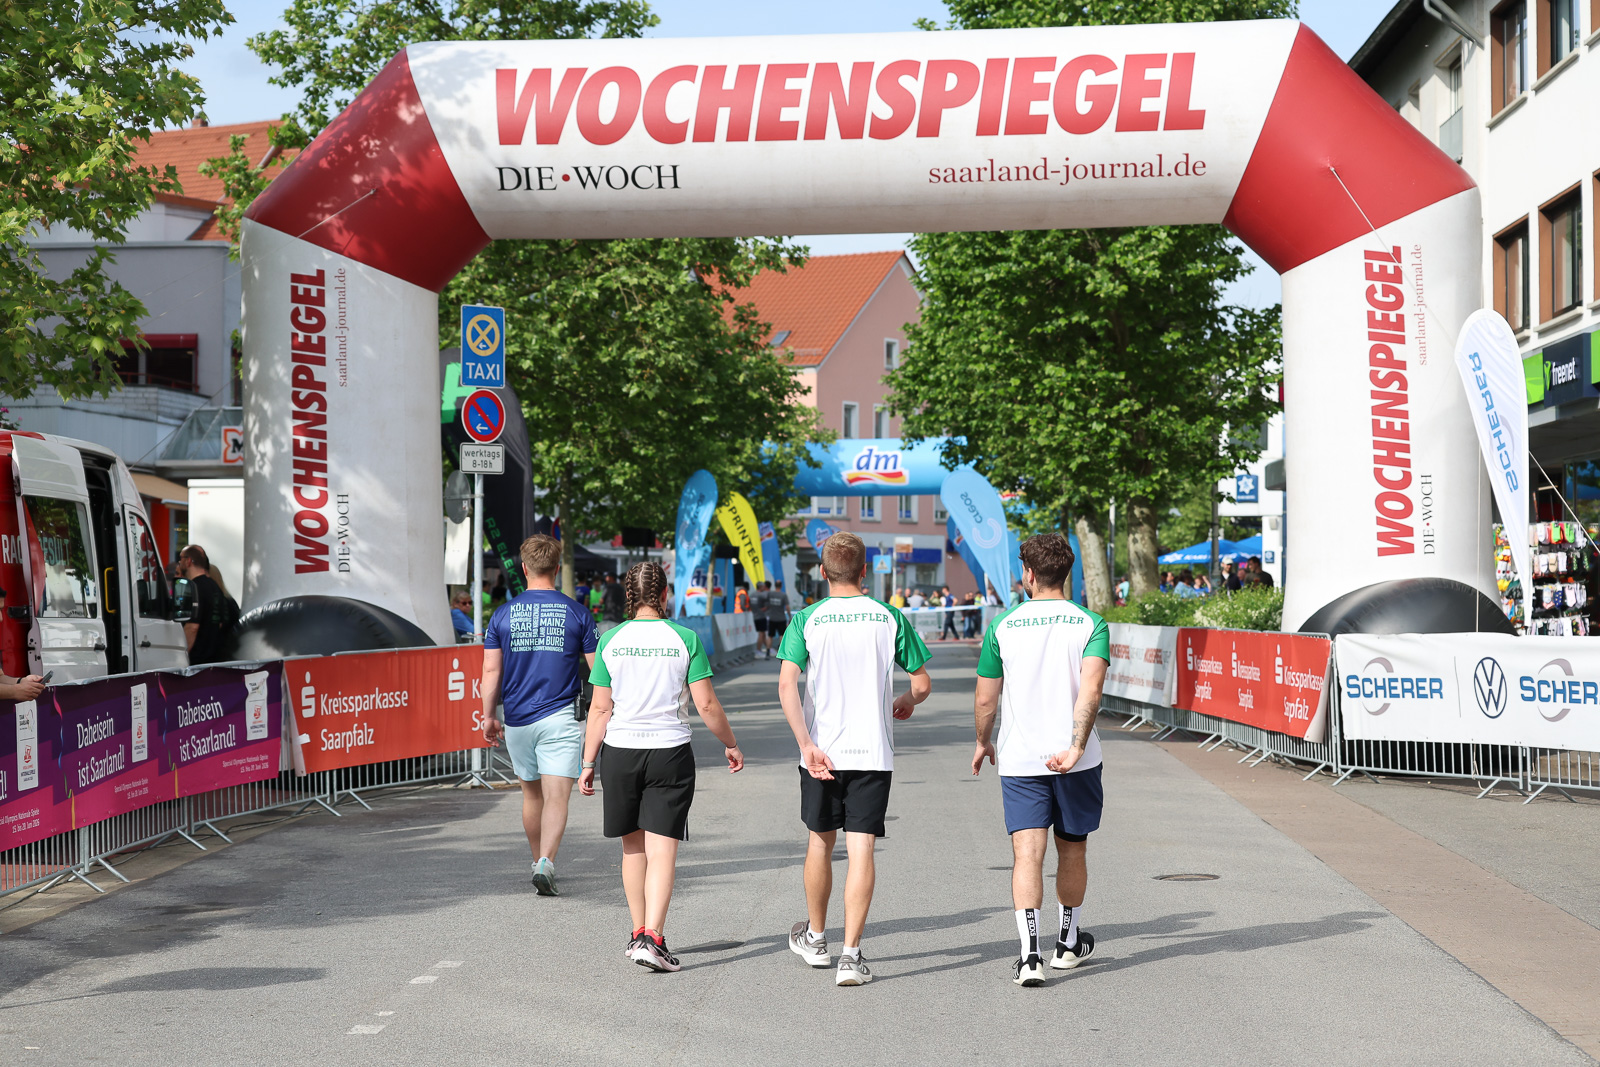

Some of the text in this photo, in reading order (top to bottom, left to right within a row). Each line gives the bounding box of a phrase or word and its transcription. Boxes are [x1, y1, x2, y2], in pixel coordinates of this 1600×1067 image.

[495, 52, 1206, 146] WOCHENSPIEGEL
[929, 153, 1207, 185] saarland-journal.de
[1410, 244, 1427, 366] saarland-journal.de
[335, 267, 350, 387] saarland-journal.de
[465, 362, 500, 380] TAXI
[1552, 357, 1576, 386] freenet
[1364, 245, 1415, 557] WOCHENSPIEGEL
[290, 268, 329, 574] WOCHENSPIEGEL
[464, 449, 501, 460] werktags
[856, 448, 898, 471] dm
[723, 498, 760, 567] SPRINTER
[1, 534, 23, 564] RAC
[510, 602, 532, 612] KÖLN
[814, 612, 889, 626] SCHAEFFLER
[1006, 614, 1085, 628] SCHAEFFLER
[510, 622, 532, 632] SAAR
[540, 618, 566, 628] MAINZ
[546, 627, 565, 636] LUXEM
[546, 636, 565, 647] BURG
[612, 647, 680, 657] SCHAEFFLER
[1346, 674, 1443, 699] SCHERER
[1519, 676, 1600, 705] SCHER
[177, 696, 223, 728] Dabeisein
[320, 687, 408, 717] Kreissparkasse
[76, 712, 115, 749] Dabeisein
[179, 739, 190, 762] ist
[191, 724, 236, 759] Saarland!
[320, 722, 375, 753] Saarpfalz
[78, 761, 89, 788] ist
[90, 744, 125, 783] Saarland!
[1028, 919, 1036, 936] SOCKS
